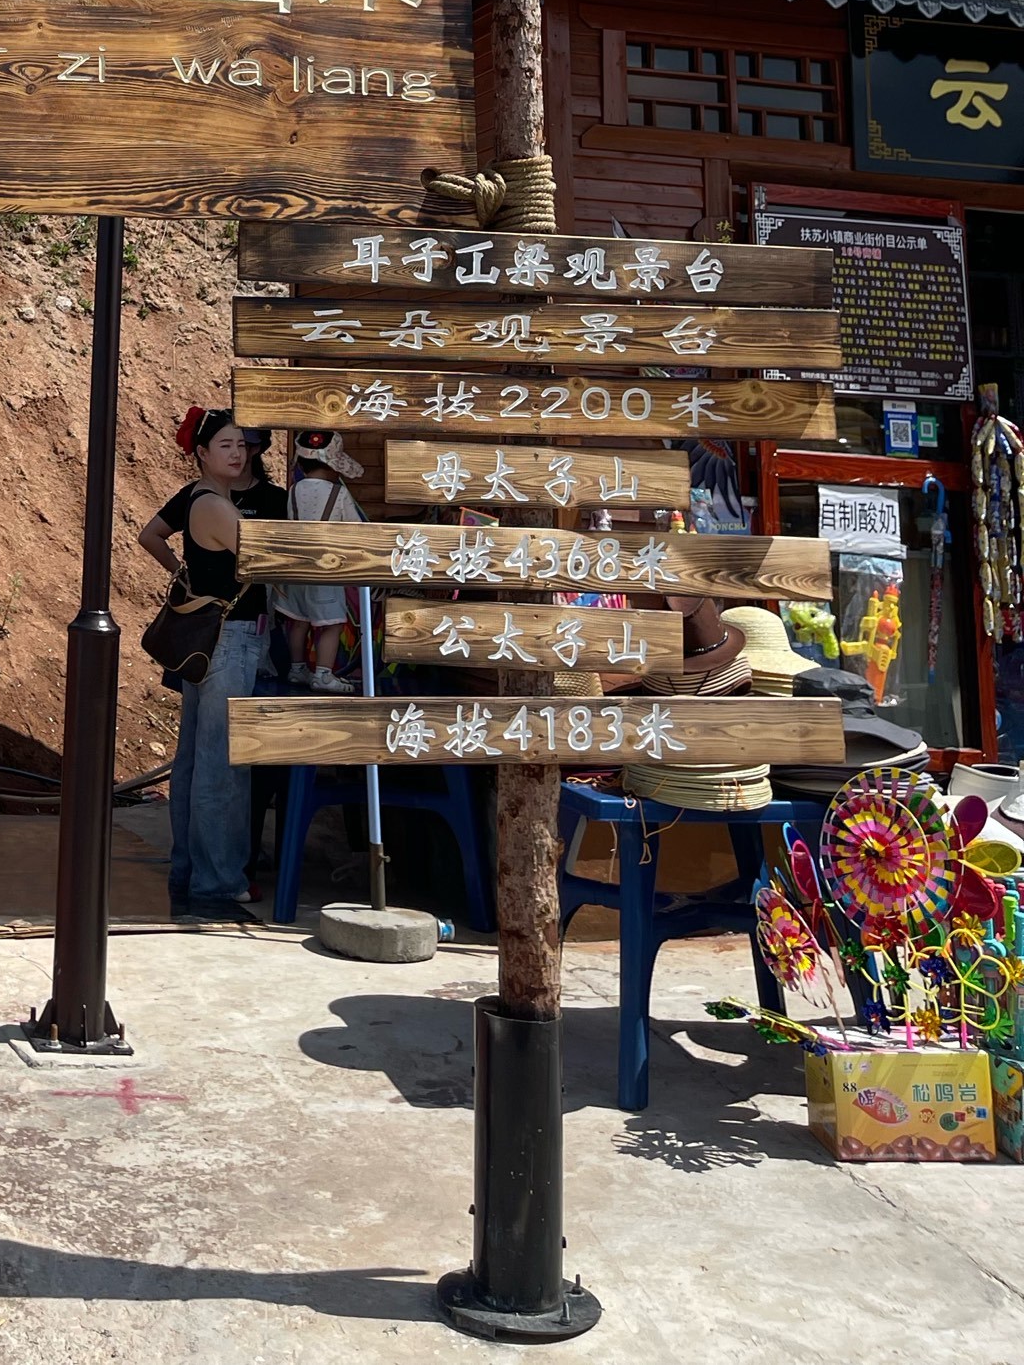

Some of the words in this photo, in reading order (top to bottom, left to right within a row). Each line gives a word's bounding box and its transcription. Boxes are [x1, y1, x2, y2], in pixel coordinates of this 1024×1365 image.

[56, 45, 107, 83] zi
[171, 52, 263, 87] wa
[292, 55, 438, 103] liang
[929, 58, 1009, 131] 云
[292, 308, 721, 355] 云朵观景台
[344, 379, 730, 428] 海拔2200米
[422, 448, 640, 507] 母太子山
[821, 498, 897, 535] 自制酸奶
[390, 529, 680, 590] 海拔4368米
[432, 611, 649, 667] 公太子山
[385, 702, 688, 761] 海拔4183米
[912, 1083, 977, 1103] 松鸣岩
